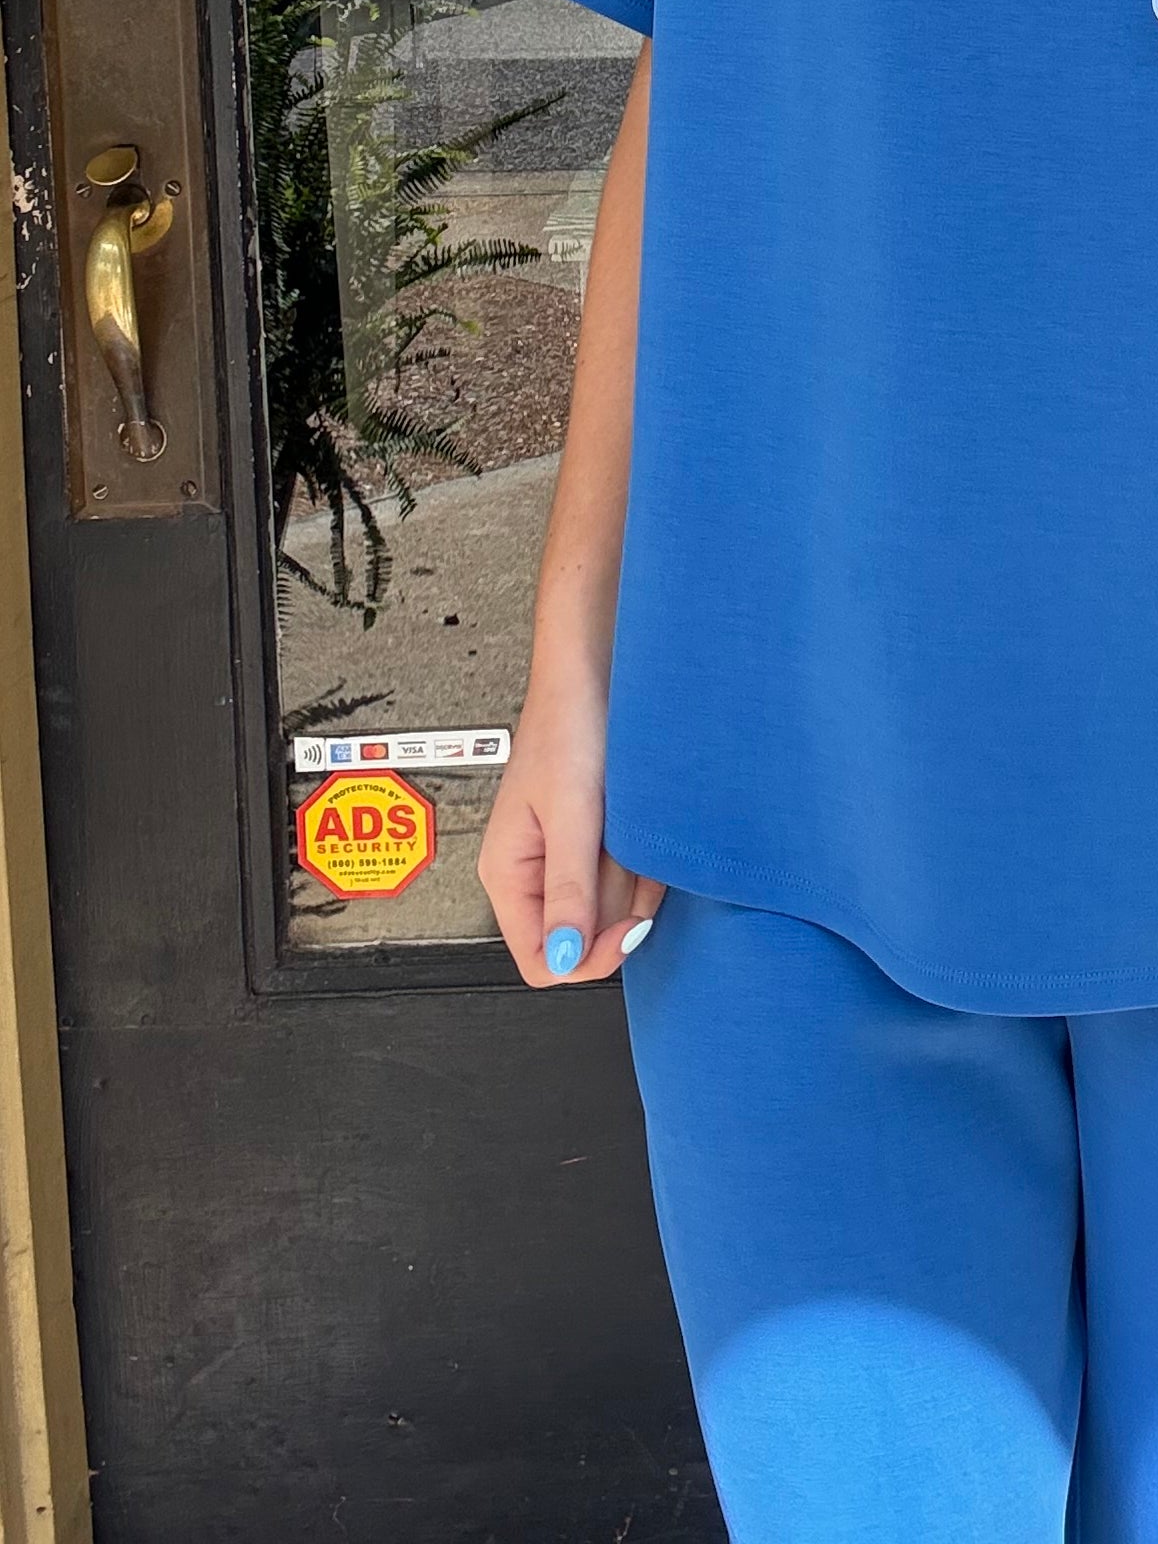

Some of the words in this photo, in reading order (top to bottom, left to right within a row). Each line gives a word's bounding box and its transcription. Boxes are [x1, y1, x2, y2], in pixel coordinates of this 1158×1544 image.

[402, 746, 424, 755] VISA
[328, 784, 386, 804] PROTECTION
[388, 790, 401, 801] BY
[314, 804, 417, 842] ADS
[317, 840, 417, 854] SECURITY
